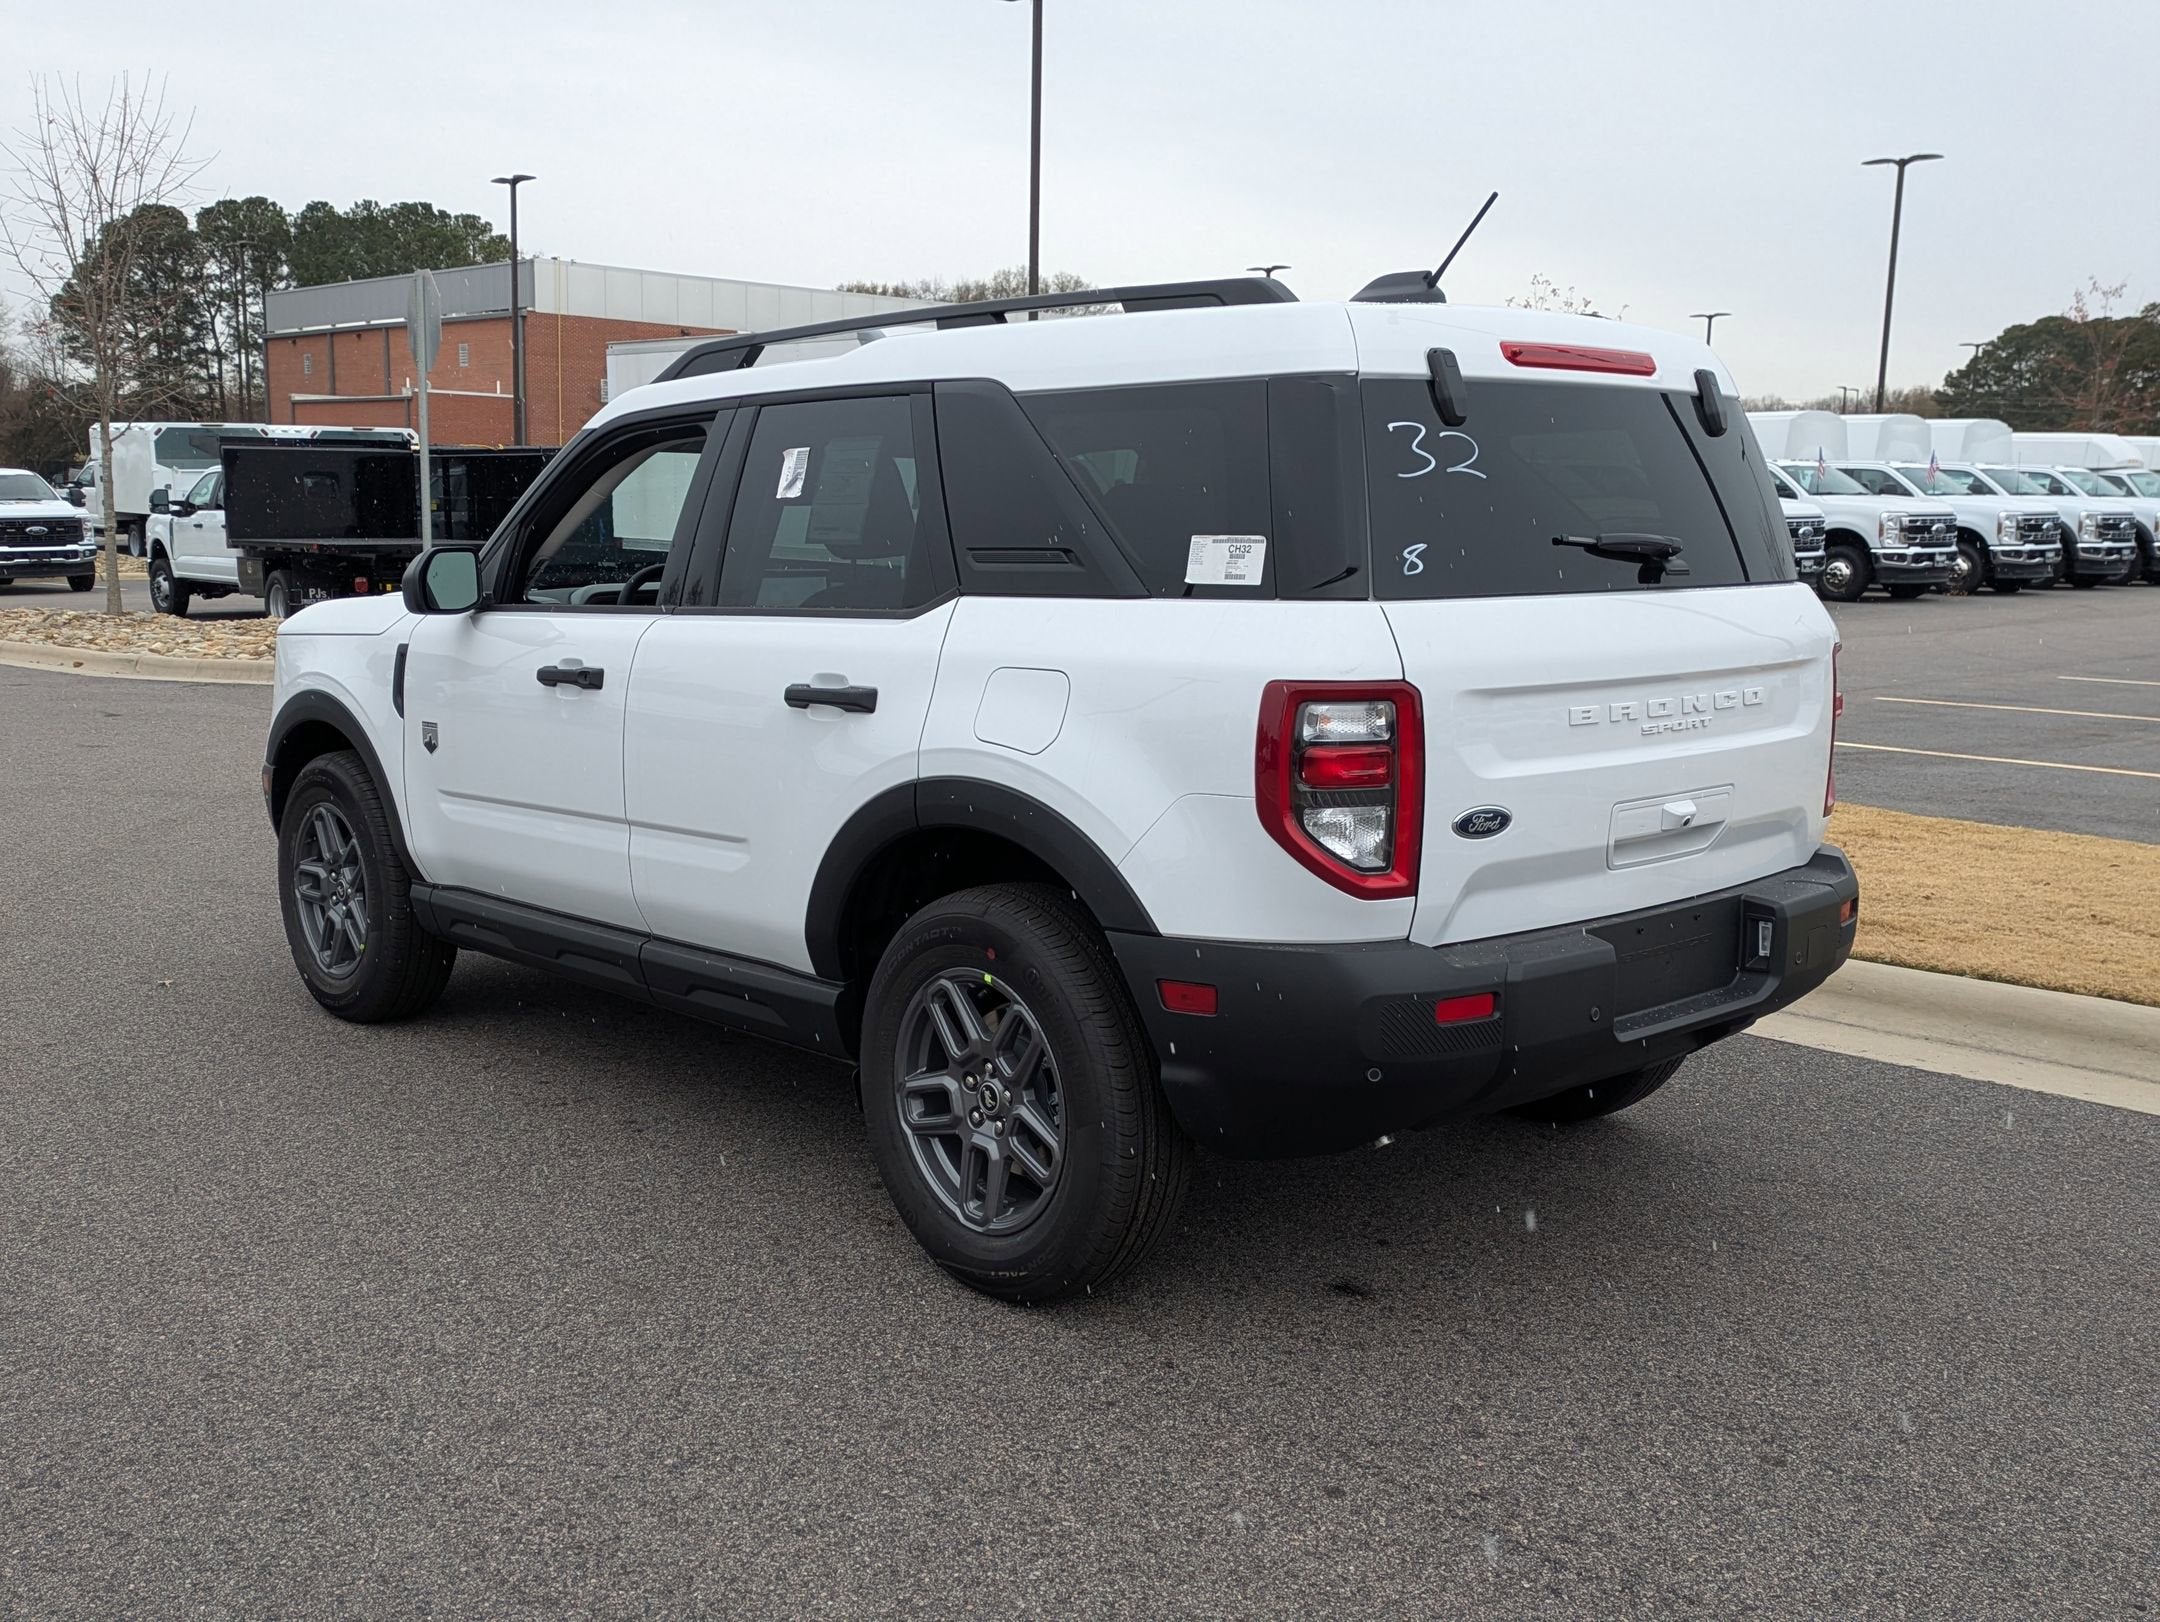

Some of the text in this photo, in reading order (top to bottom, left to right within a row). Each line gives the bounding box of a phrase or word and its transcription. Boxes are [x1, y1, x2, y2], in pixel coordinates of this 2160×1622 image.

[1387, 421, 1487, 478] 32
[1228, 544, 1252, 554] CH32
[1403, 543, 1428, 575] 8
[1568, 686, 1765, 727] BRONCO
[1641, 716, 1713, 735] SPORT
[1468, 813, 1502, 833] Ford
